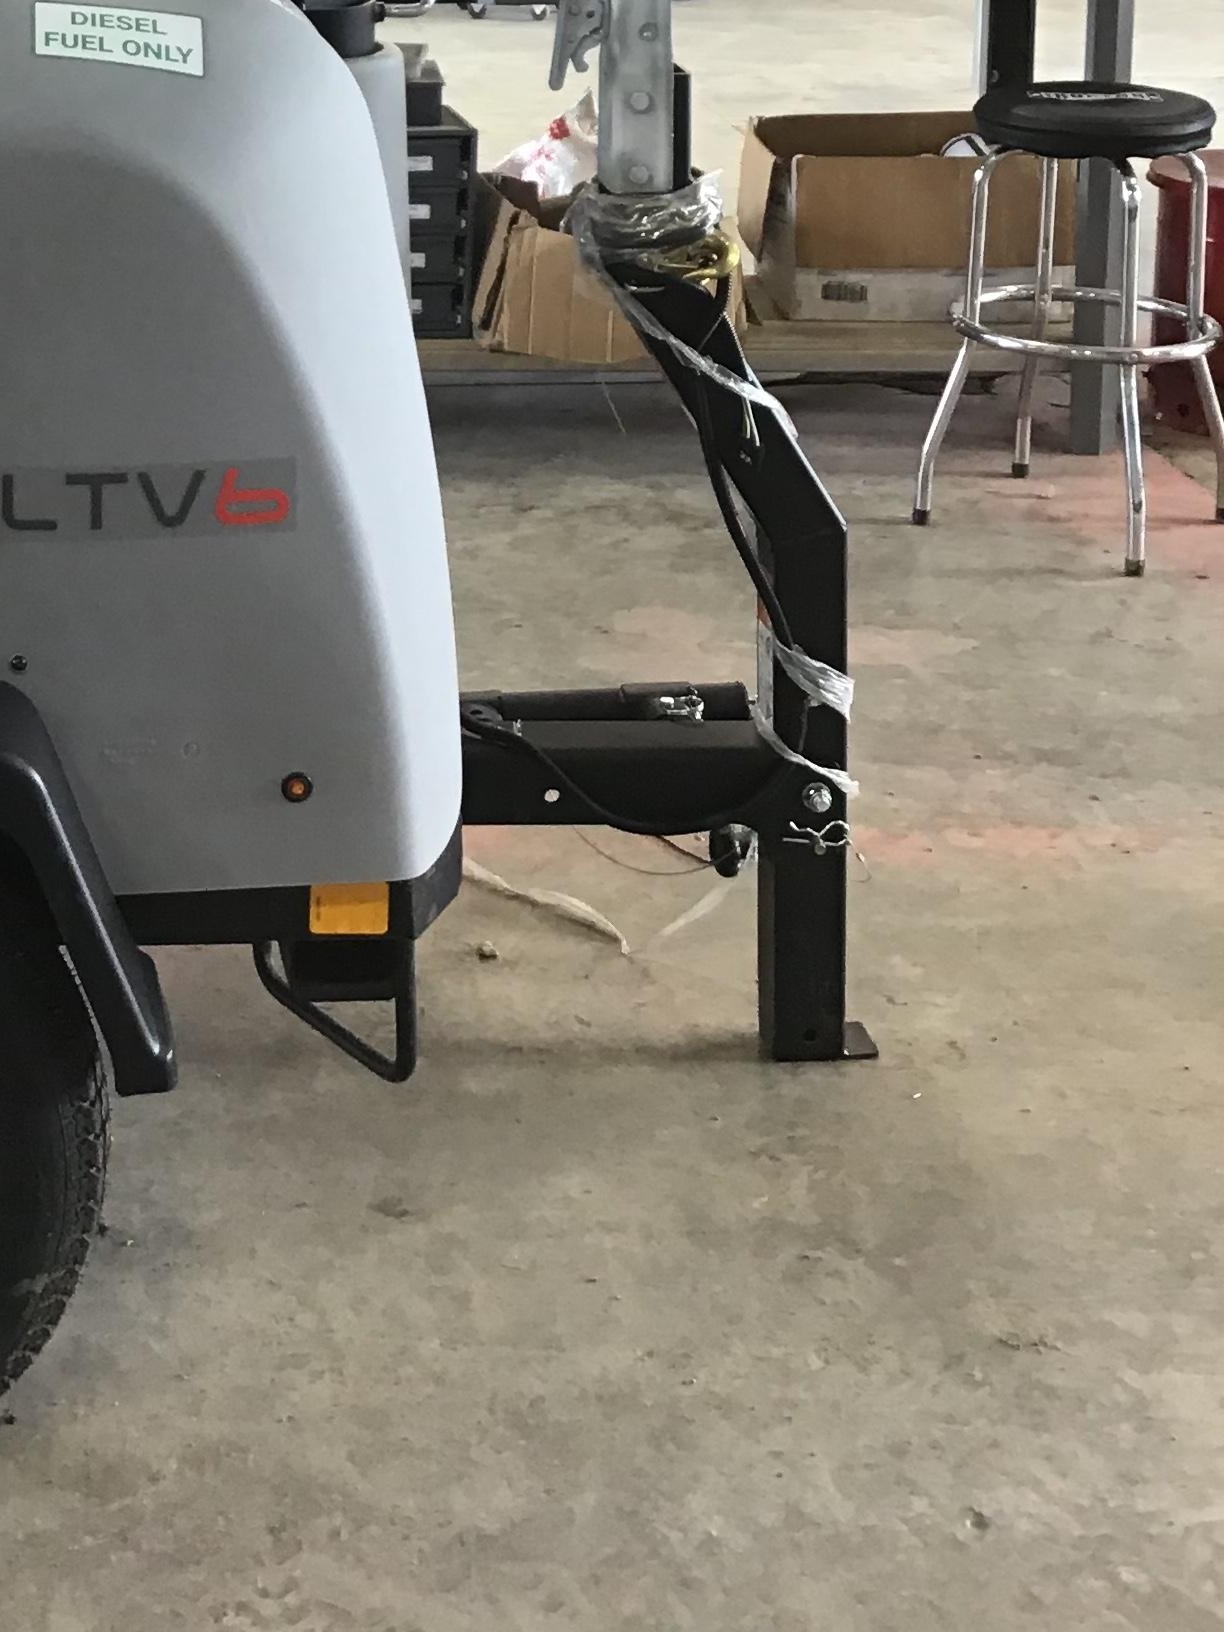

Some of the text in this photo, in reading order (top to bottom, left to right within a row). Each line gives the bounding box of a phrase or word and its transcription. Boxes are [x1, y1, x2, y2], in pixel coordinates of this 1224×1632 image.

[70, 11, 168, 36] DIESEL
[44, 31, 194, 65] FUEL ONLY
[1, 467, 290, 531] LTV6
